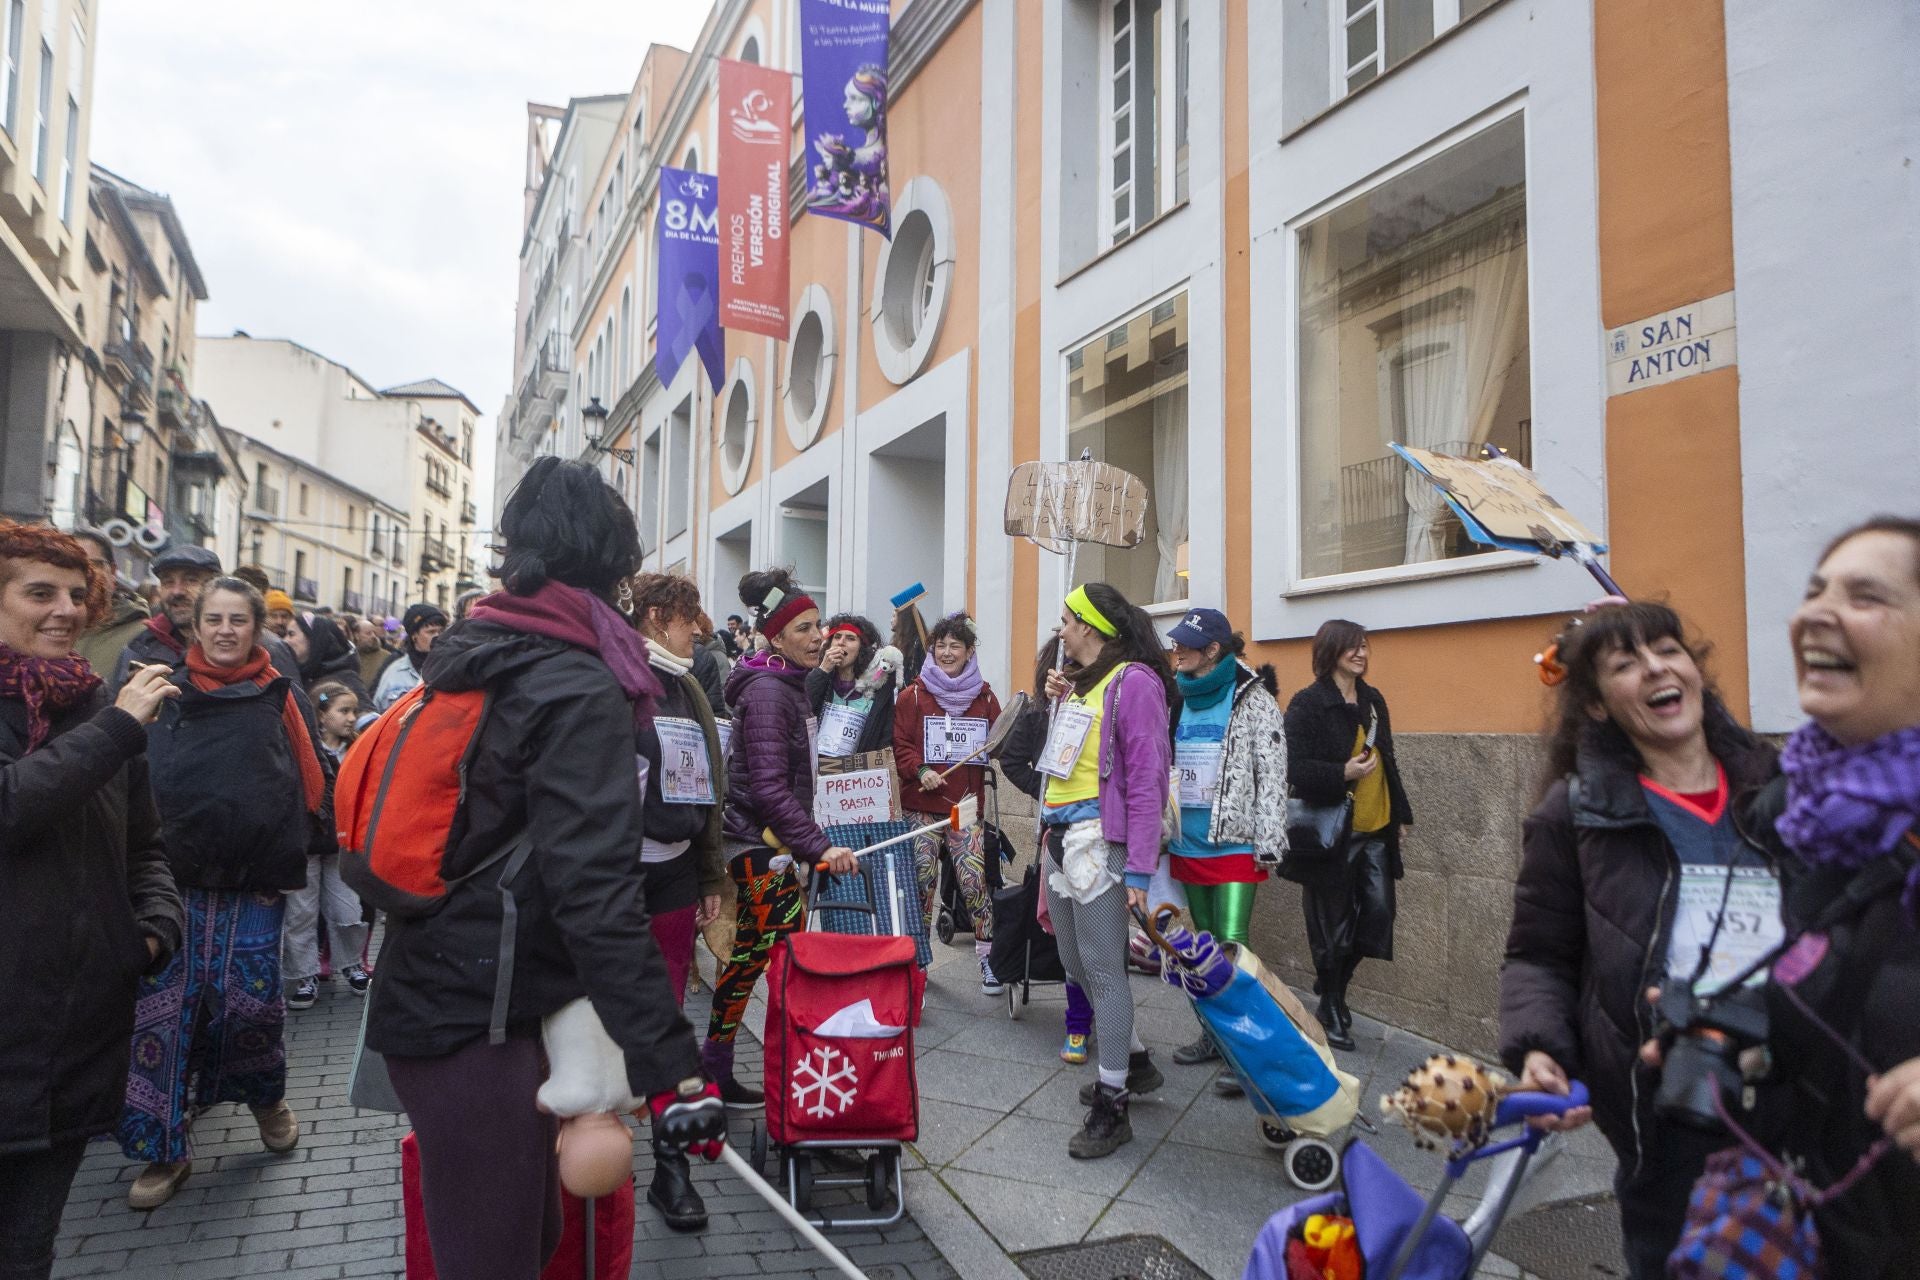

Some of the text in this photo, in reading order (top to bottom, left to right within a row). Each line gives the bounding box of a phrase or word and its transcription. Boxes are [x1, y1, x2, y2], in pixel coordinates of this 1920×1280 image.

[664, 199, 719, 235] 8M
[767, 160, 782, 240] ORIGINAL
[680, 231, 690, 241] DE
[691, 233, 701, 242] LA
[746, 193, 764, 268] VERSIÓN
[731, 213, 745, 286] PREMIOS
[1641, 313, 1692, 349] SAN
[1628, 339, 1711, 383] ANTON
[842, 726, 858, 740] 055
[1180, 768, 1197, 781] 736
[1705, 909, 1762, 934] 457
